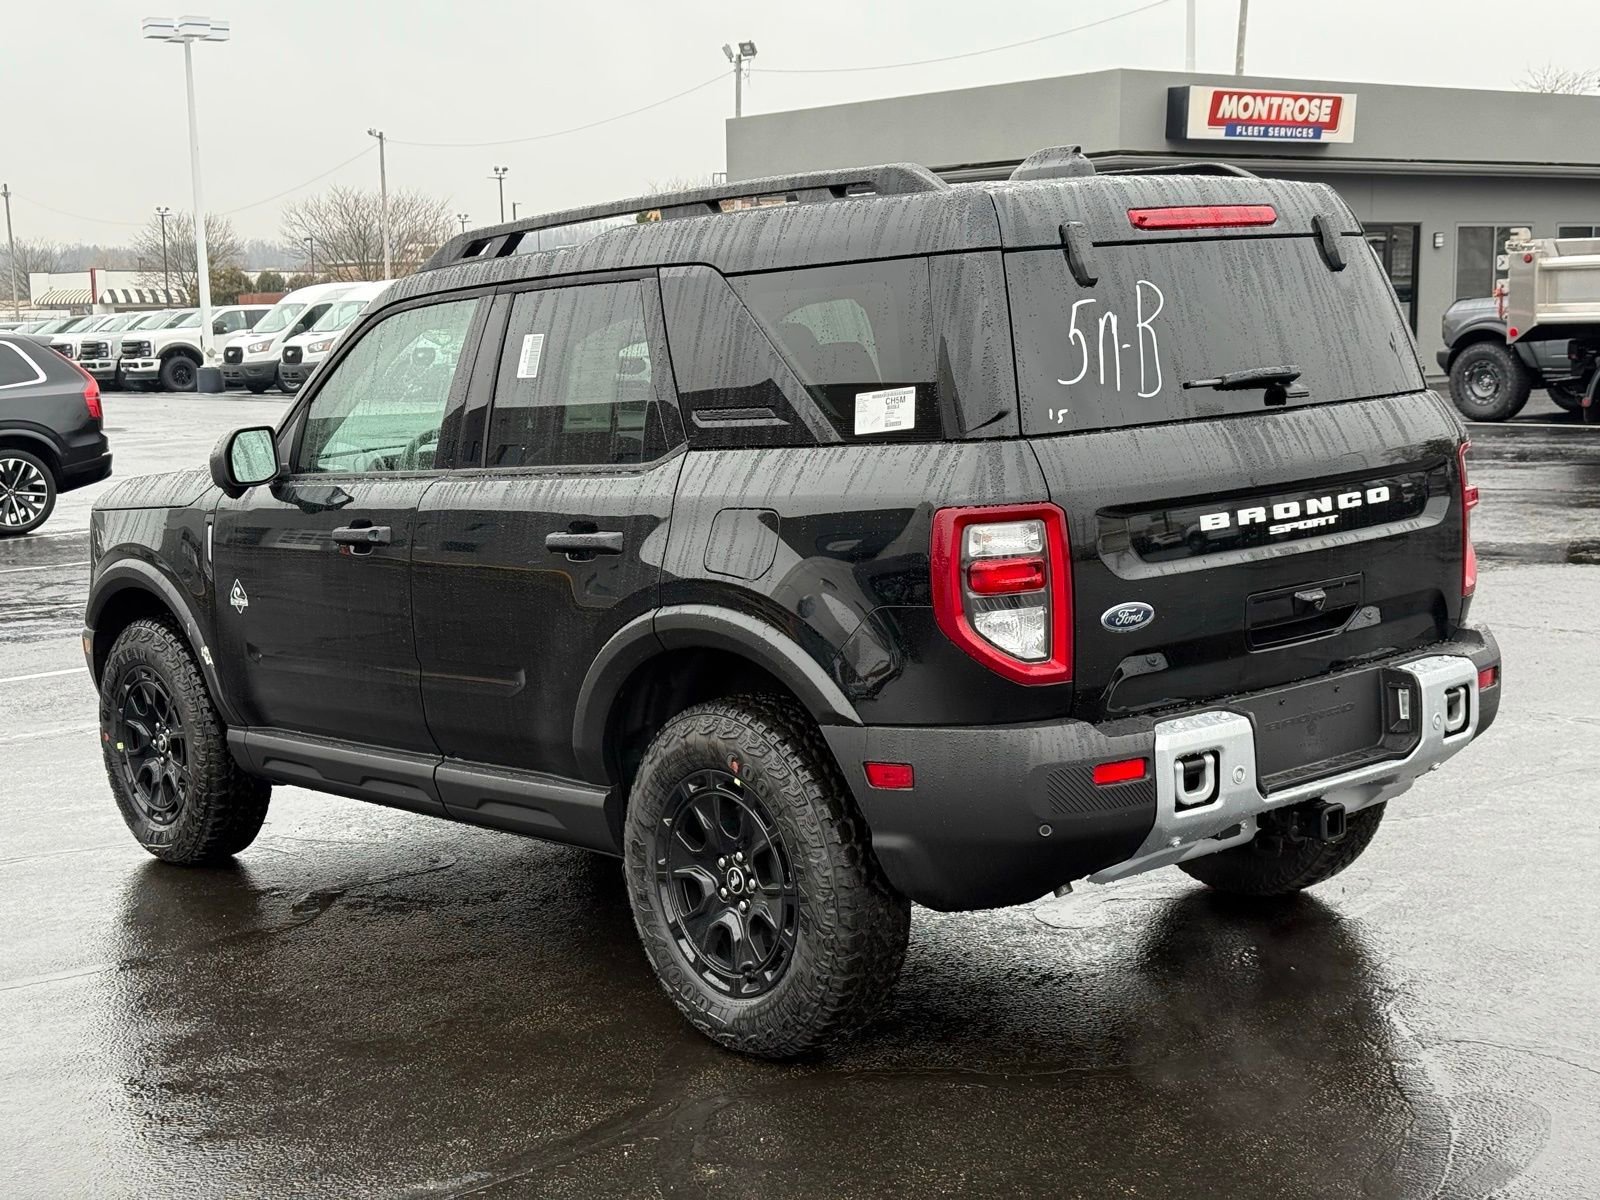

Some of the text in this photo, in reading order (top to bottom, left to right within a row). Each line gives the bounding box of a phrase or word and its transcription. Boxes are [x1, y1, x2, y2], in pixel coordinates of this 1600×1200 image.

[1216, 94, 1334, 123] MONTROSE
[1236, 125, 1314, 138] FLEET SERVICES
[885, 395, 906, 405] CH5M
[1200, 486, 1390, 532] BRONCO
[1268, 514, 1339, 535] SPORT
[1115, 608, 1144, 626] Ford
